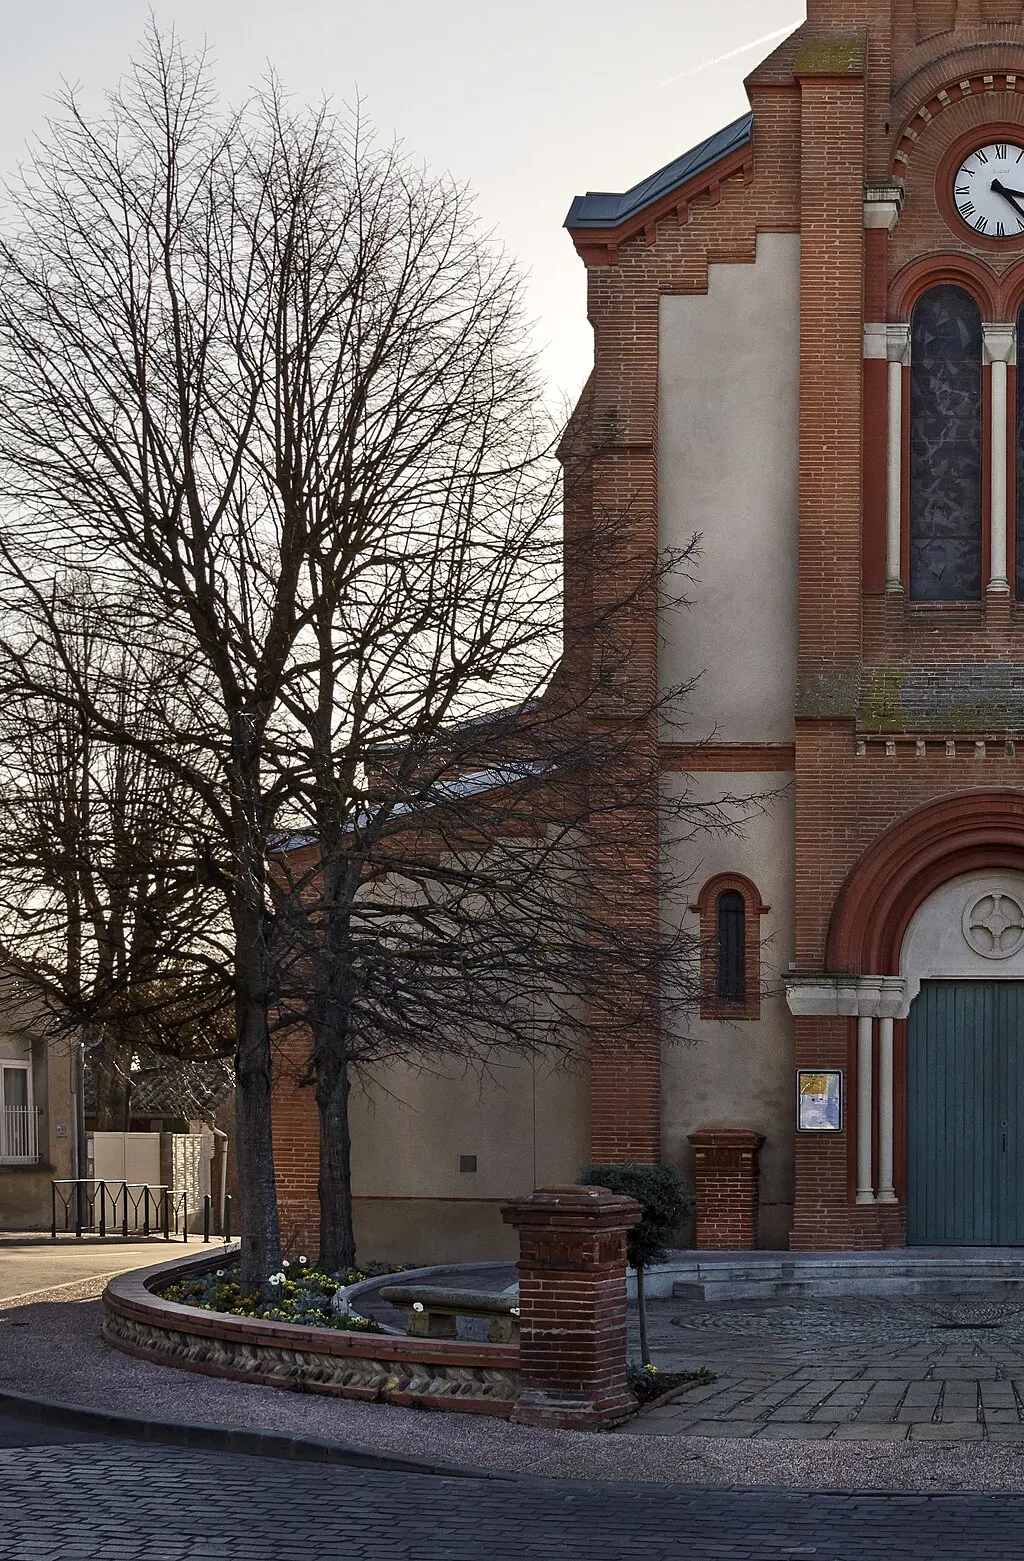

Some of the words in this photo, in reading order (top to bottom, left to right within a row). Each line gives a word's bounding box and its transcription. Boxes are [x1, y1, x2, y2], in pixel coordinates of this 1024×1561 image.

[975, 150, 988, 166] XI
[995, 145, 1007, 159] XII
[1016, 150, 1024, 164] I
[961, 166, 975, 177] X
[956, 186, 970, 194] IX
[958, 201, 976, 219] VIII
[974, 216, 988, 232] VII
[997, 222, 1004, 235] VI
[1016, 218, 1024, 230] V
